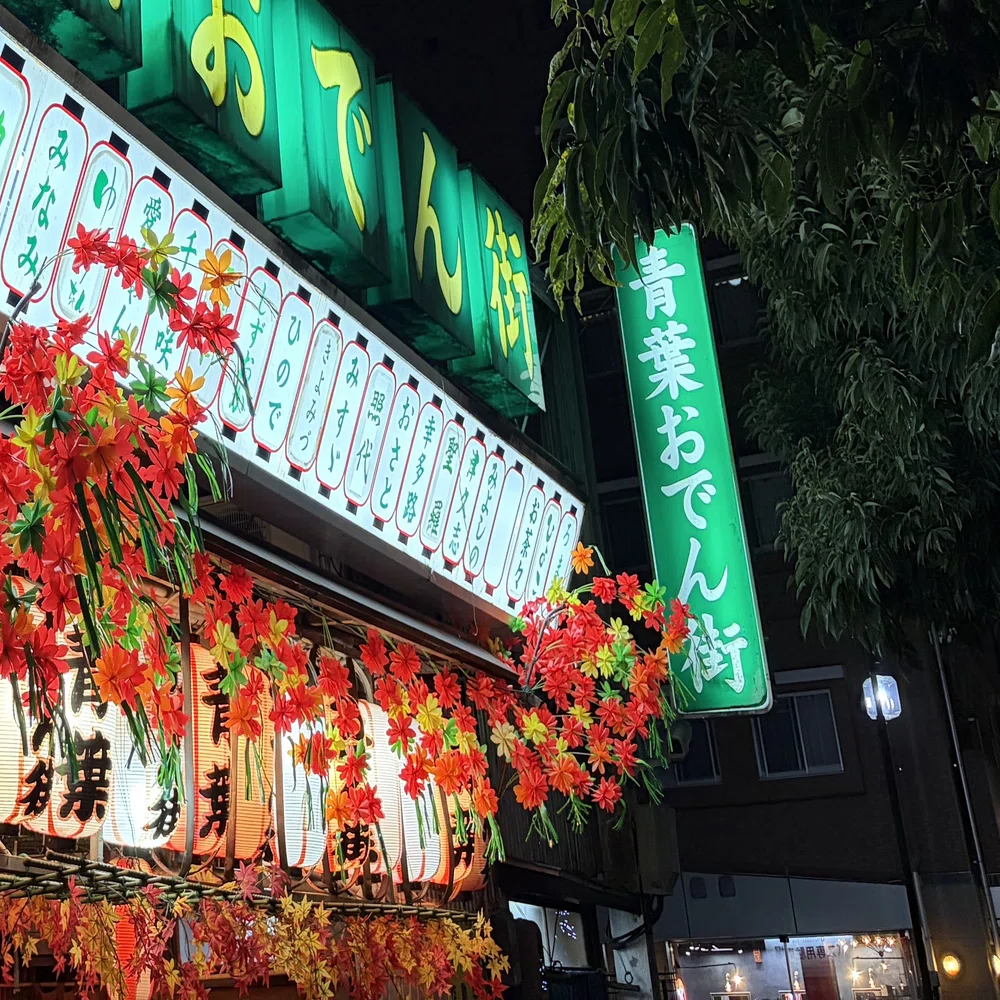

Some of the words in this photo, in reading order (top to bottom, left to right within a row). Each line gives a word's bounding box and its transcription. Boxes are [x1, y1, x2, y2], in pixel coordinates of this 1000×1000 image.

[16, 129, 69, 278] みなみ
[267, 315, 302, 431] ひので
[299, 338, 333, 452] きよみづ
[327, 356, 360, 473] みすじ
[355, 389, 385, 485] 照代
[379, 395, 414, 510] おさと
[402, 415, 436, 524] 幸多路
[628, 245, 750, 695] 青葉おでん街
